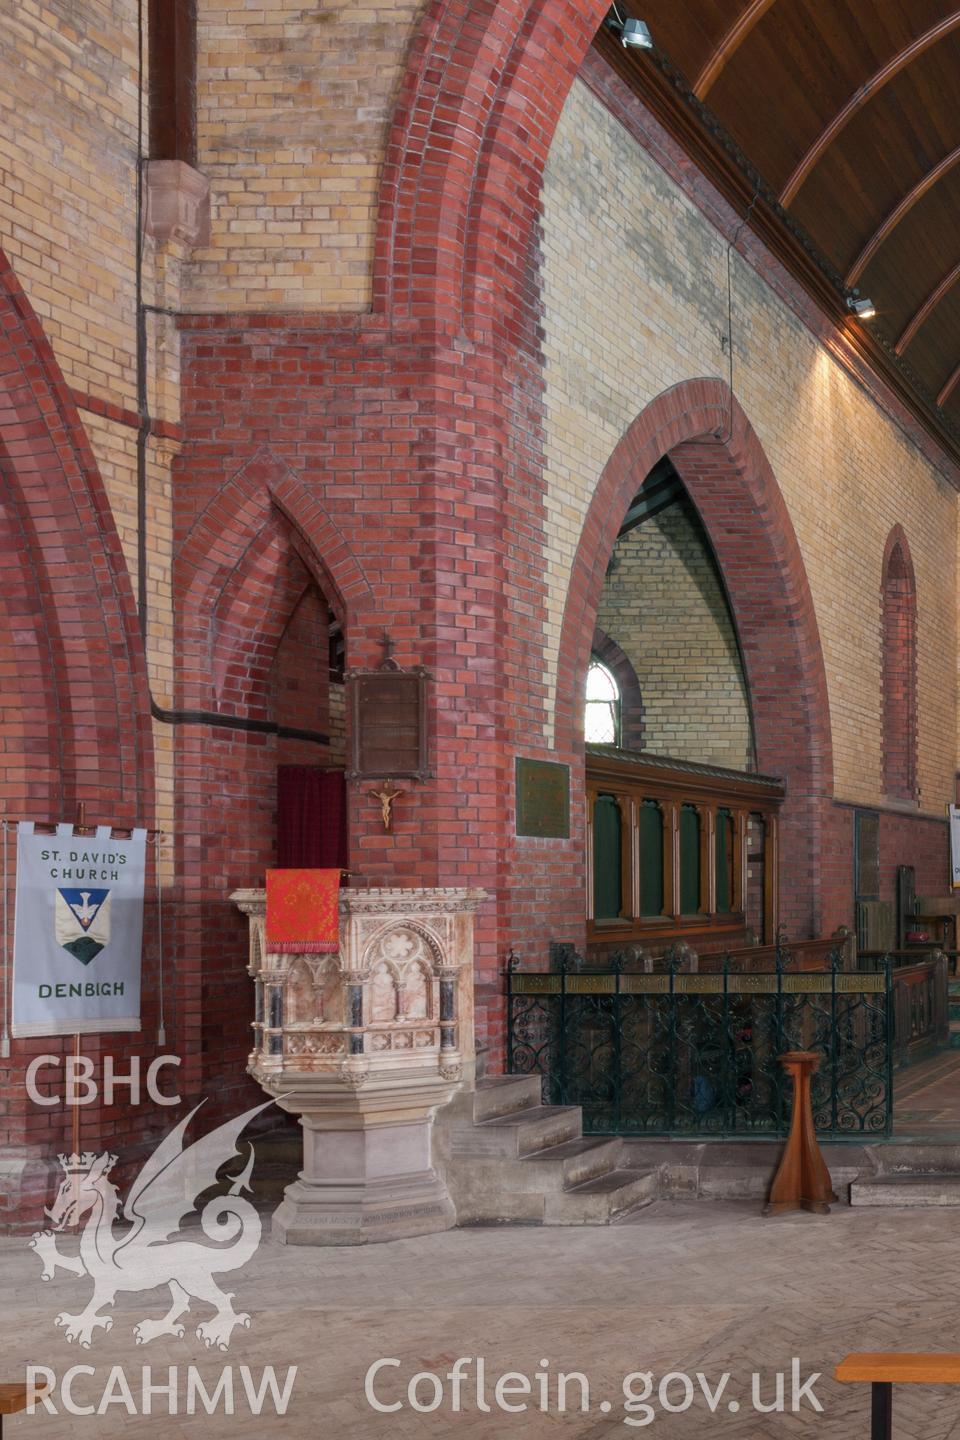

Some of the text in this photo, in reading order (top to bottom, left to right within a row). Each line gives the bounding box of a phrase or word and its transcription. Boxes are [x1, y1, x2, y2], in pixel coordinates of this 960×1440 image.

[41, 850, 127, 865] ST. DAVID'S
[50, 868, 119, 881] CHURCH
[38, 982, 125, 999] DENBIGH
